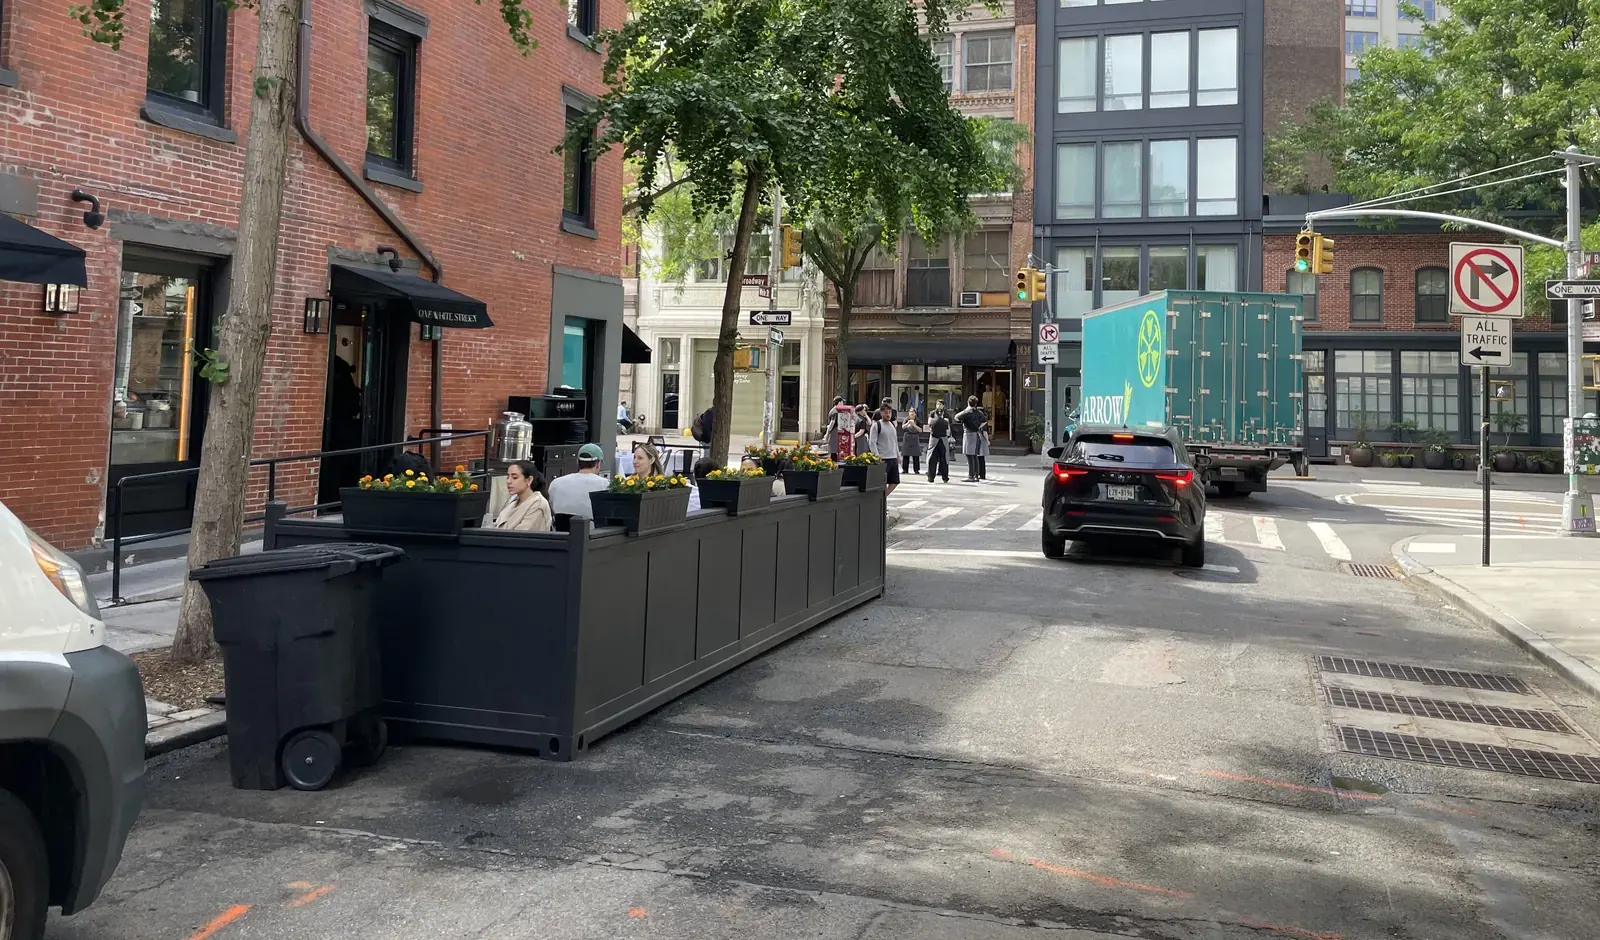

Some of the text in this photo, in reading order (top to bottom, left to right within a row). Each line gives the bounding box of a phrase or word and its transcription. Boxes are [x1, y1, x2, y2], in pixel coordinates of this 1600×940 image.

[742, 277, 765, 286] roadway
[1554, 285, 1573, 294] ONE
[418, 309, 432, 318] ONE
[1476, 320, 1498, 332] ALL
[1466, 334, 1507, 345] TRAFFIC
[1083, 395, 1124, 425] ARROW
